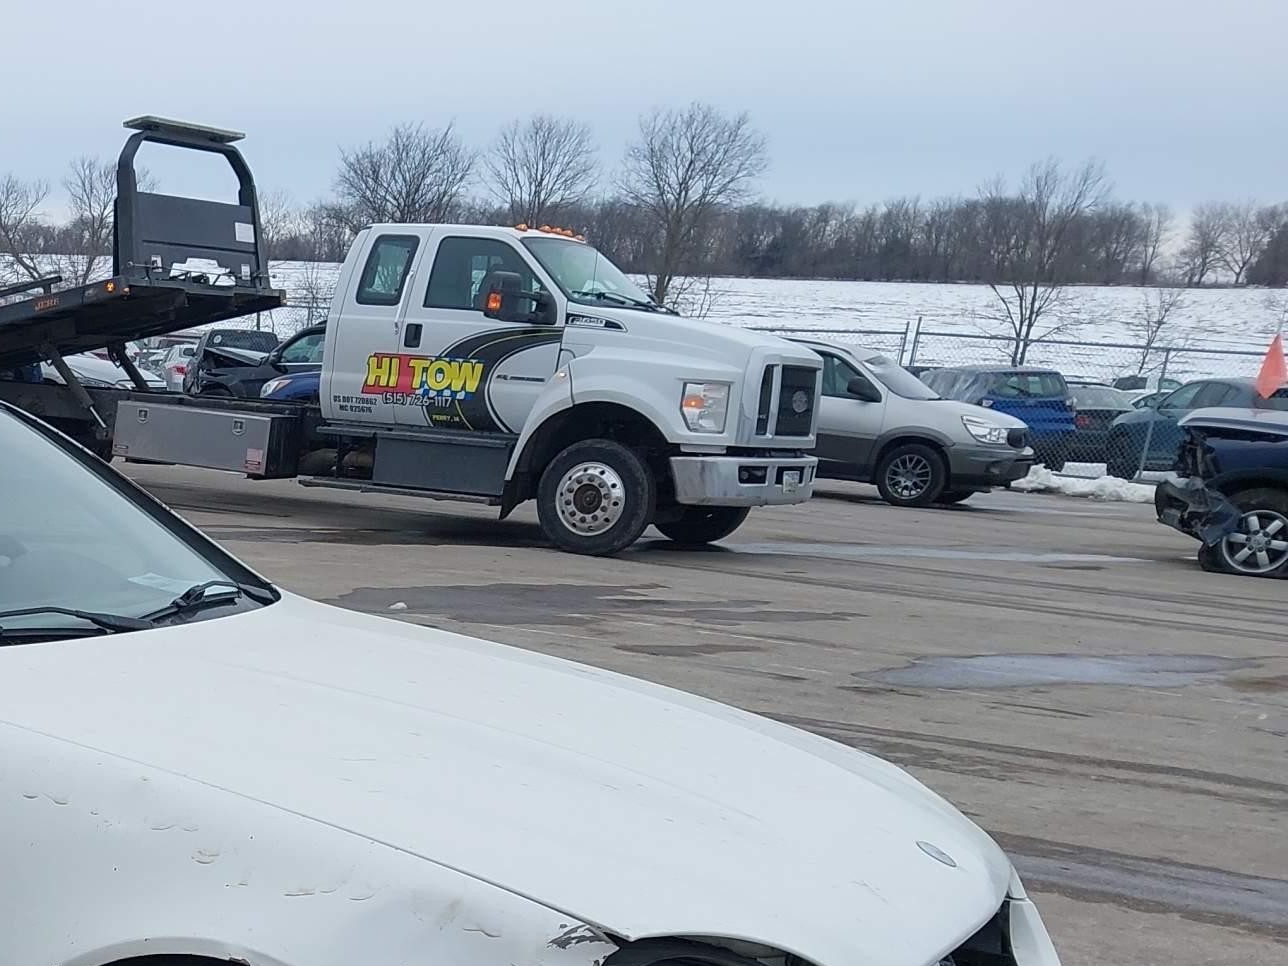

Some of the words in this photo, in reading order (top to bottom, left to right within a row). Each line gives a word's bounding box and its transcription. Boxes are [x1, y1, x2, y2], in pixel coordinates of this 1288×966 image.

[365, 356, 400, 387] HI
[408, 359, 484, 393] TOW
[382, 391, 407, 407] (515)
[409, 393, 452, 408] 726-1117
